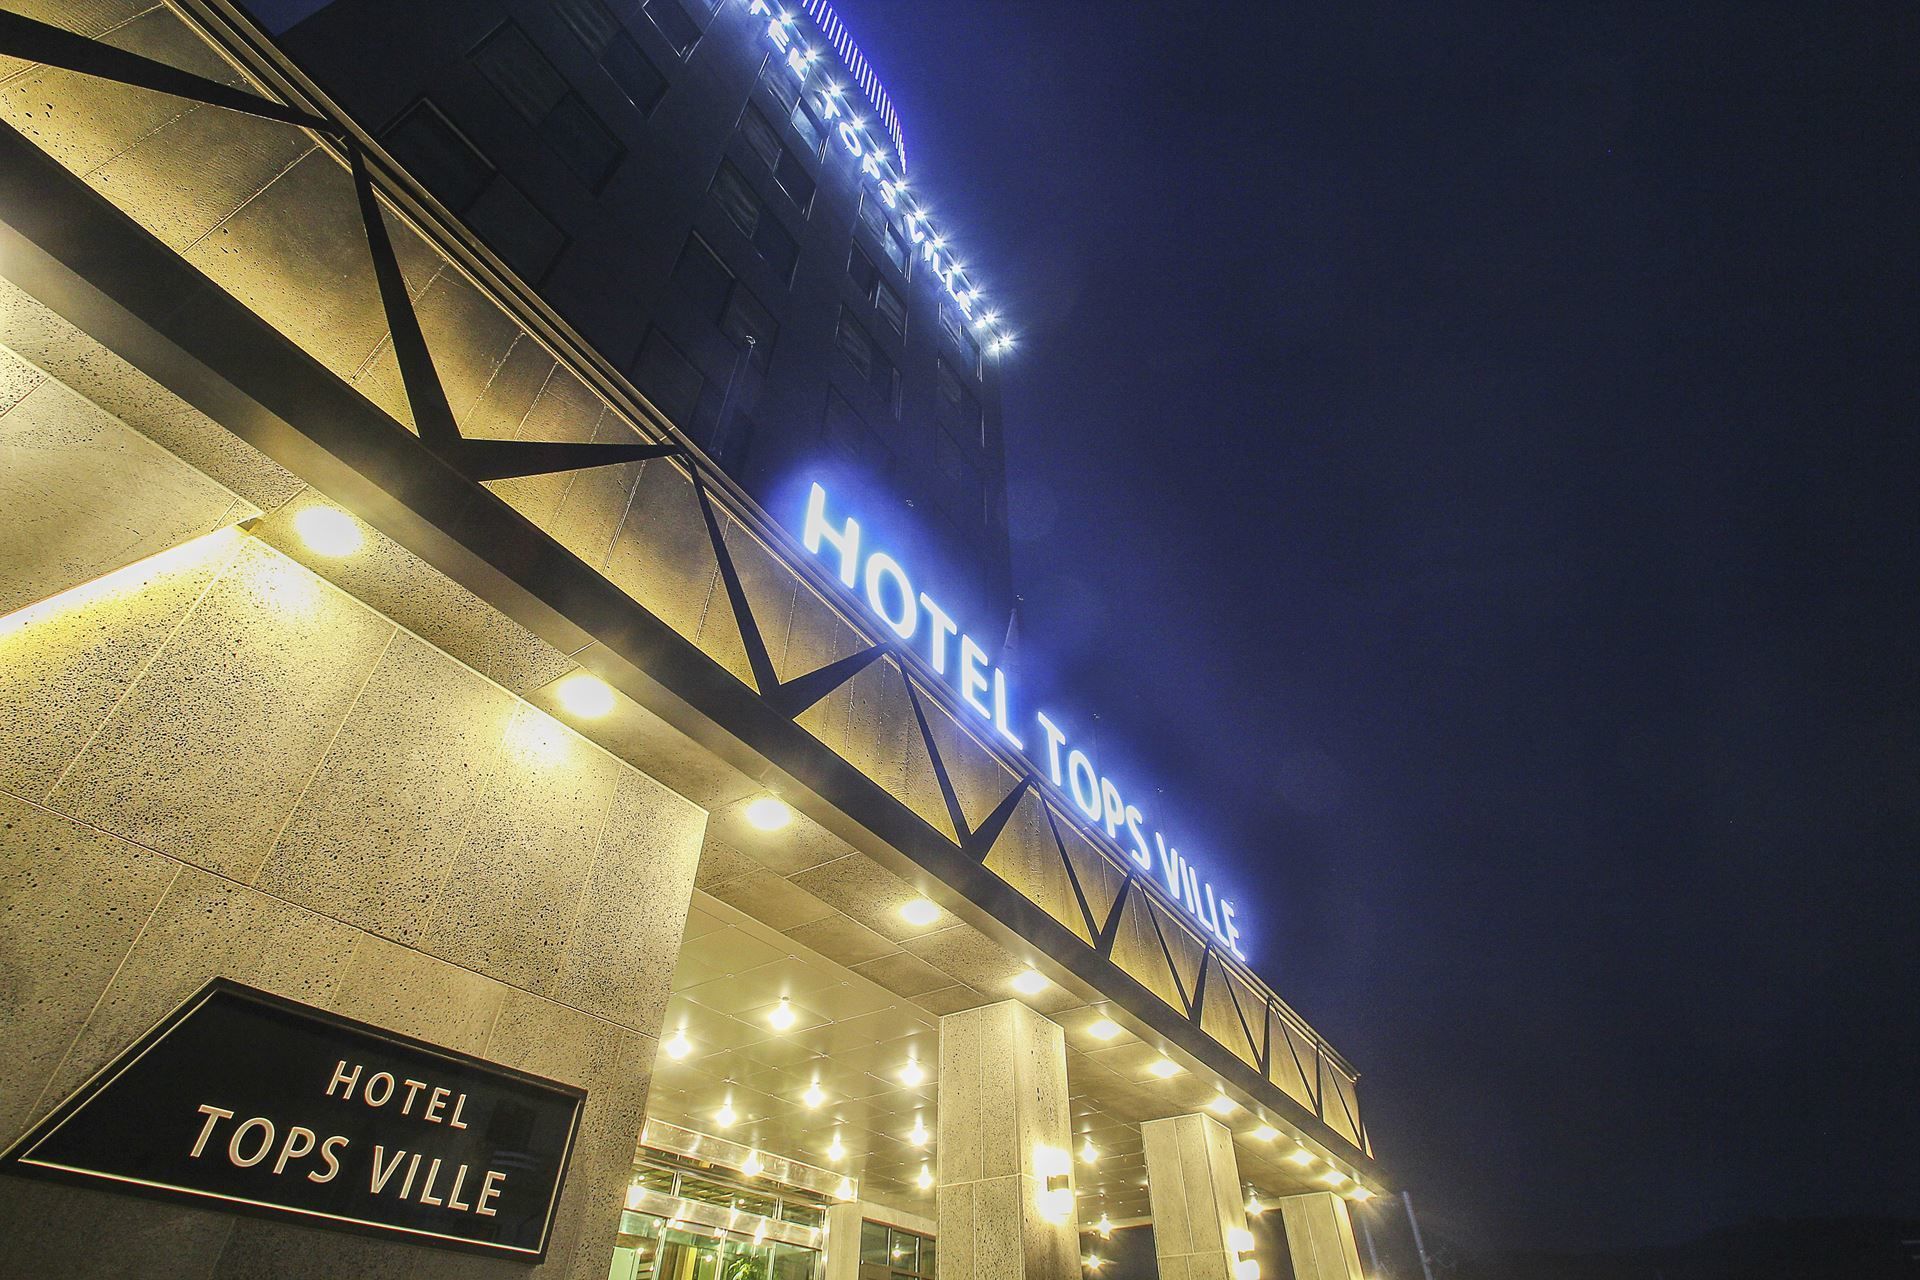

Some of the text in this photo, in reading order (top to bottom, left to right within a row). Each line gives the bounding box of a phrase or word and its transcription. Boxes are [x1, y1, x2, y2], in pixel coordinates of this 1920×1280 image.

[822, 90, 897, 209] TOPS
[903, 212, 973, 321] VILLE
[803, 481, 1247, 963] HOTEL TOPS VILLE
[189, 1103, 507, 1217] TOPS VILLE
[325, 1060, 470, 1130] HOTEL
